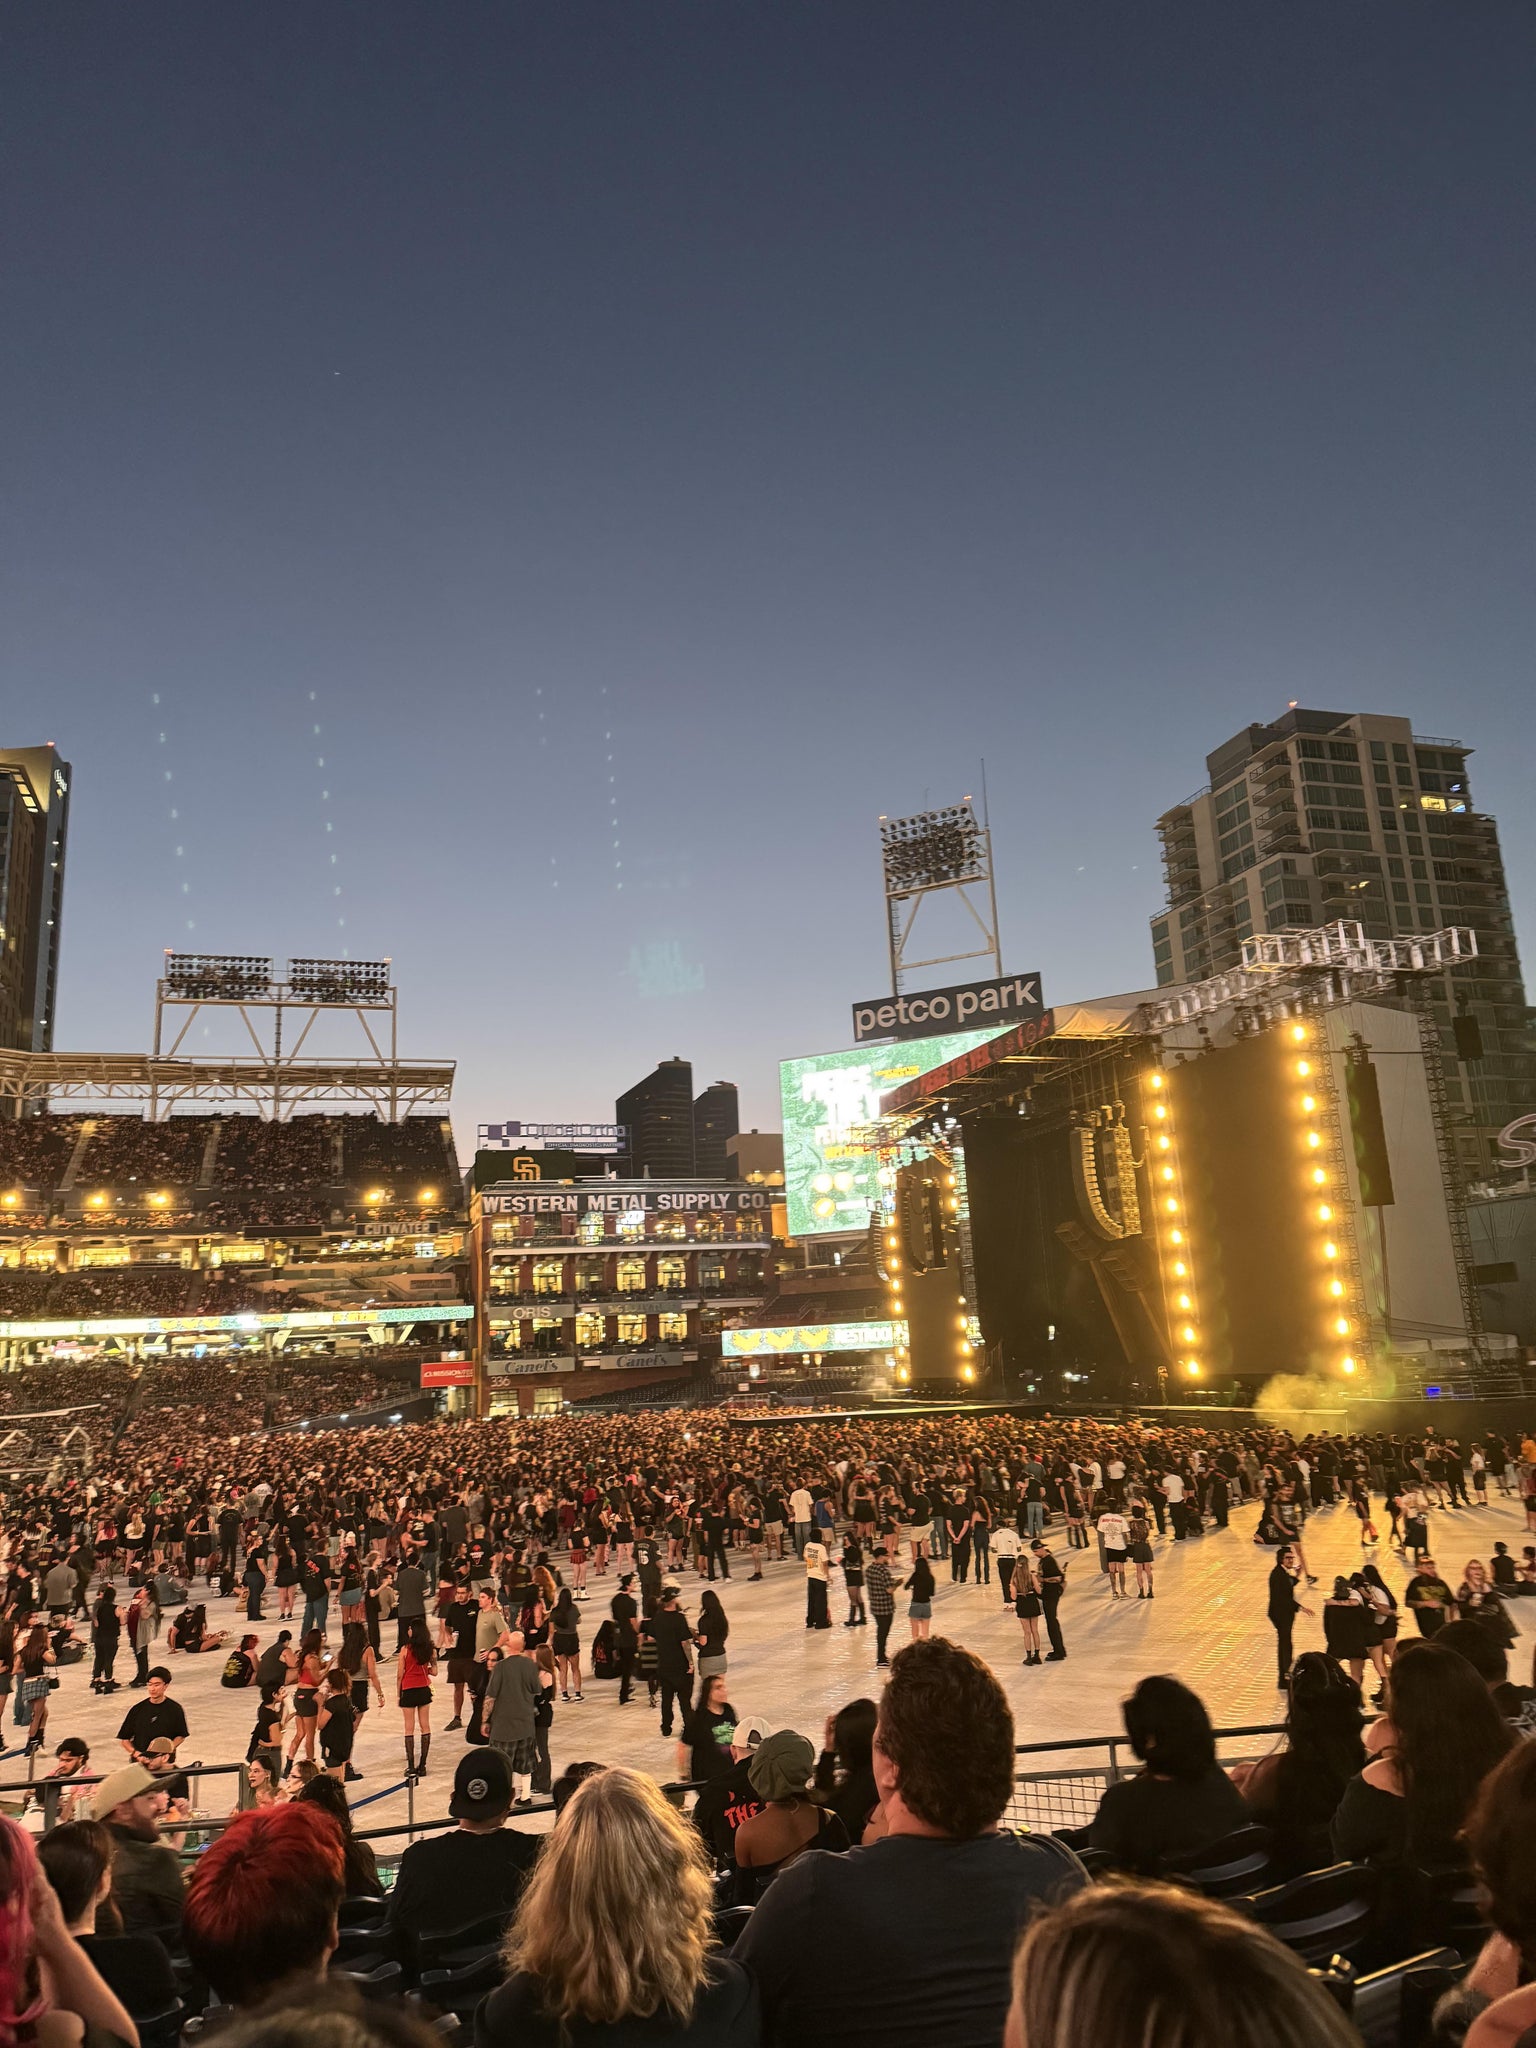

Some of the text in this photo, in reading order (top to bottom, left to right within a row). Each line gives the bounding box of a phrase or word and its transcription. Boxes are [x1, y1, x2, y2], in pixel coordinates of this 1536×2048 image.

[854, 980, 1038, 1039] petco park
[482, 1192, 770, 1213] WESTERN METAL SUPPLY CO.
[364, 1222, 430, 1235] CUTWATER
[512, 1306, 551, 1319] ORIS
[505, 1359, 559, 1374] Canel's
[616, 1353, 668, 1368] Canel's
[490, 1376, 511, 1388] 336
